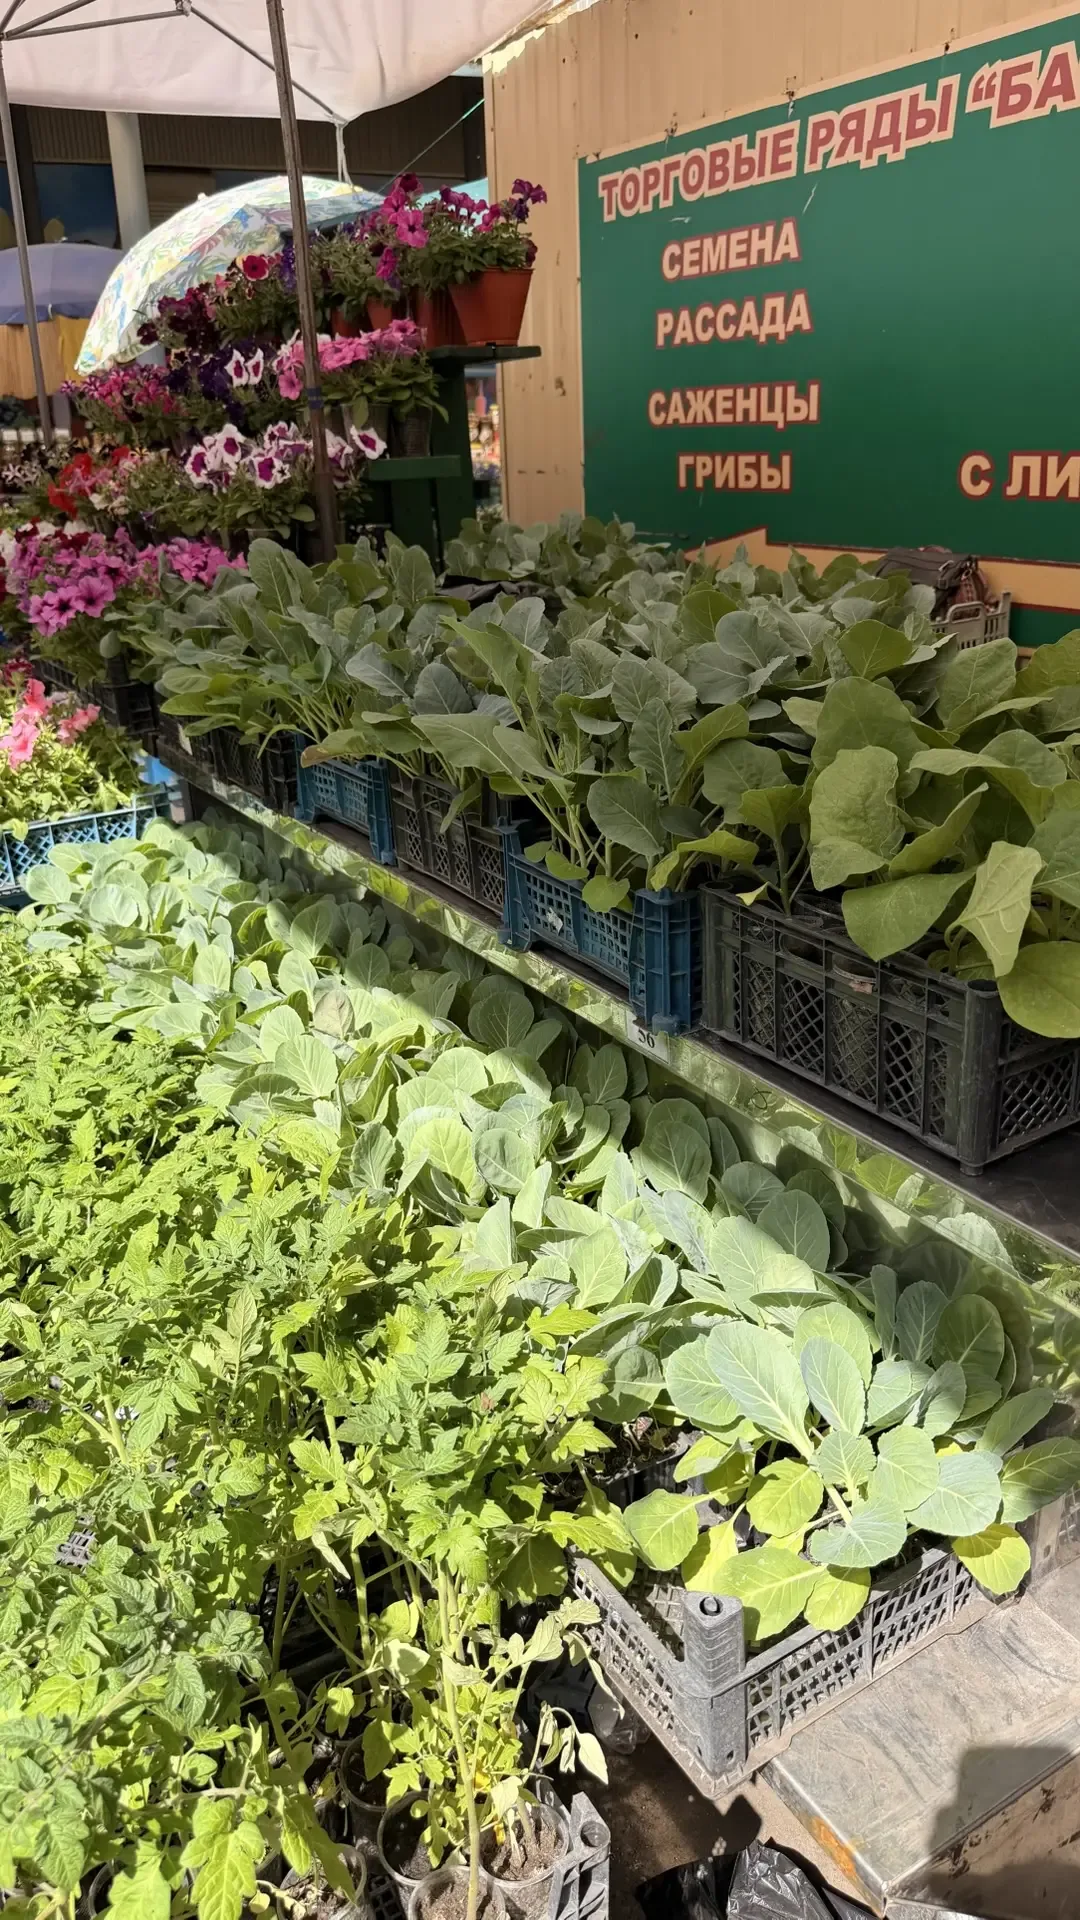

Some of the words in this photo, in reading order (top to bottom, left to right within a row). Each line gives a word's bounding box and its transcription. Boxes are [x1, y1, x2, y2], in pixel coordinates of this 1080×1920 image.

[601, 126, 797, 219] ТОРГОВЫЕ
[805, 81, 956, 164] РЯДЫ
[662, 220, 800, 280] СЕМЕНА
[656, 292, 812, 346] РАССАДА
[648, 382, 820, 428] САЖЕНЦЫ
[678, 454, 793, 491] ГРИБЫ
[960, 454, 992, 497] С
